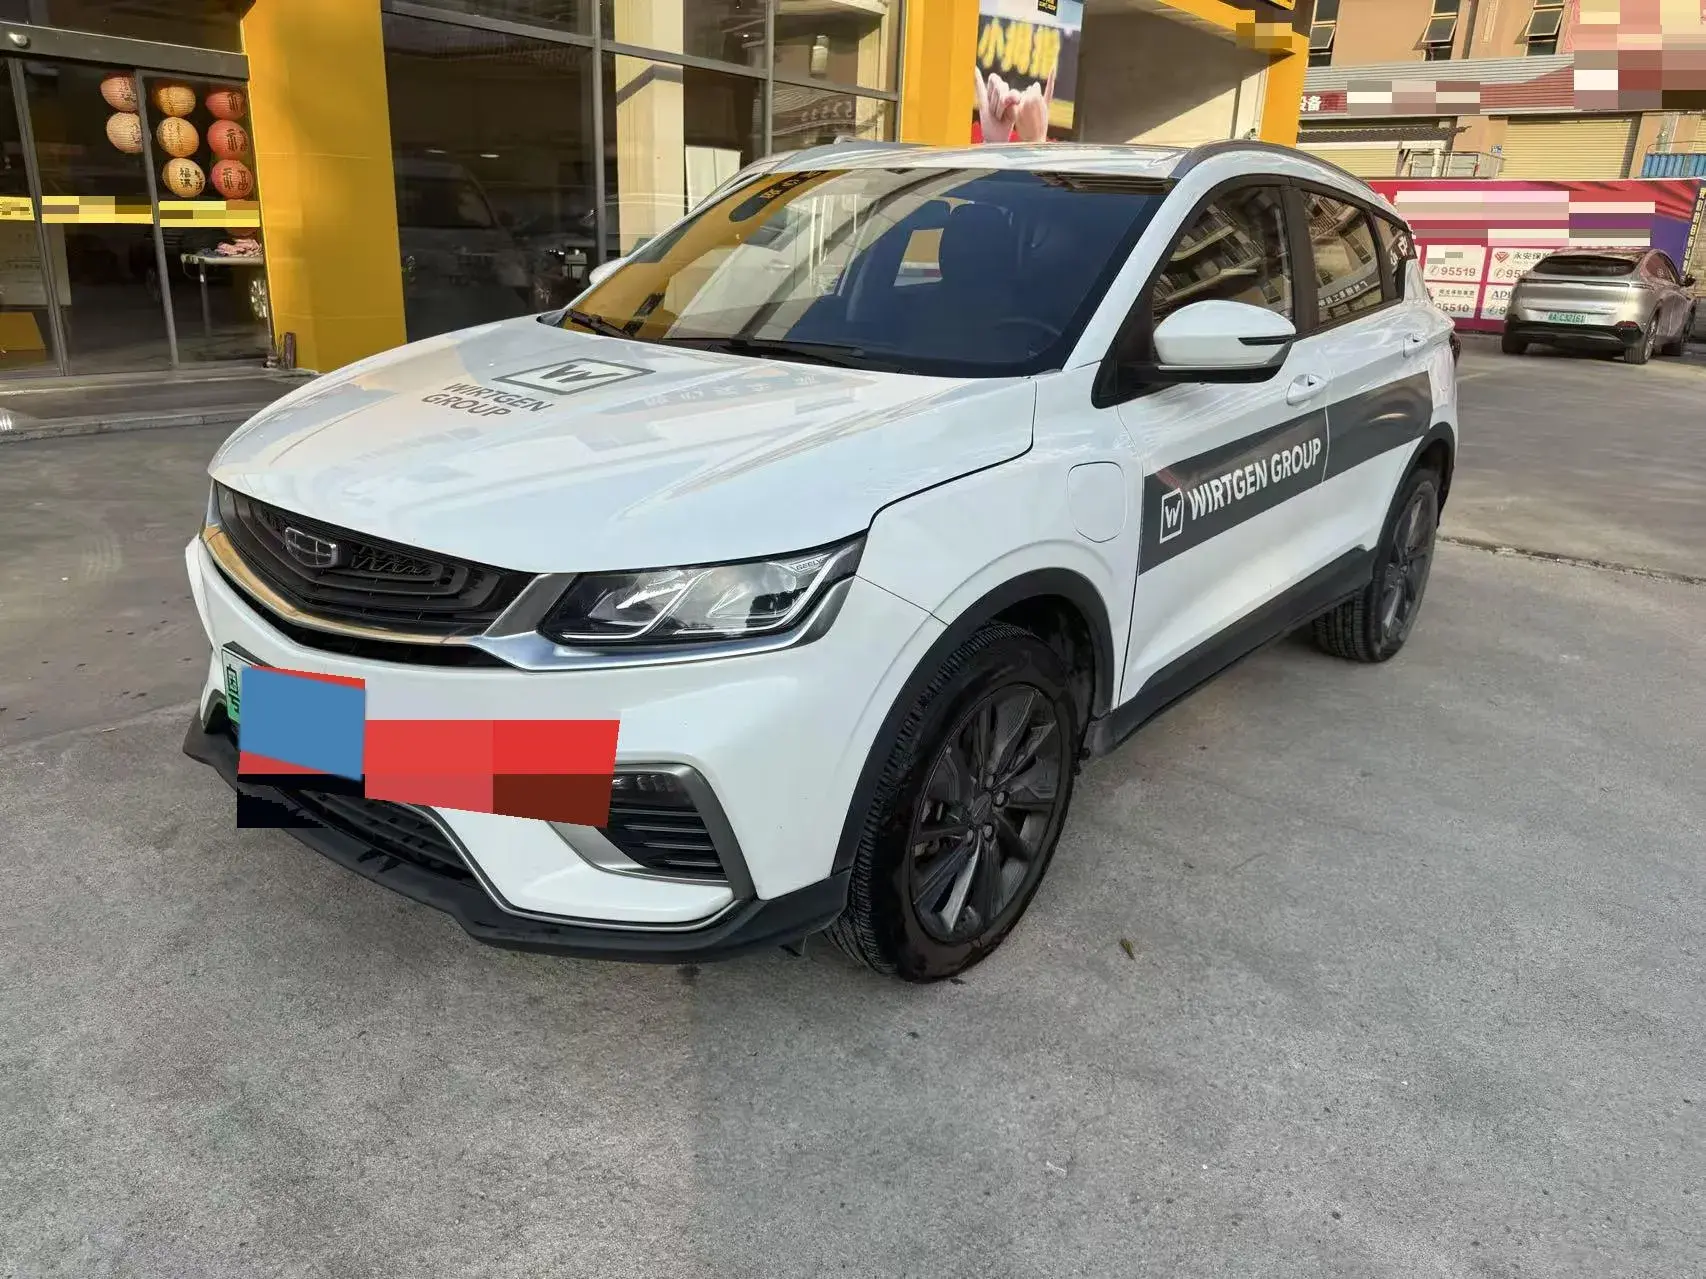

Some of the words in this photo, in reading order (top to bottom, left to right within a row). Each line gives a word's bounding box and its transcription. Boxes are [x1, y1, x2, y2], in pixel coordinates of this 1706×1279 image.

[1441, 267, 1476, 277] 95519
[421, 393, 512, 417] GROUP
[443, 382, 555, 412] WIRTGEN
[1187, 459, 1268, 521] WIRTGEN
[1270, 437, 1322, 484] GROUP
[796, 559, 823, 570] GEELY
